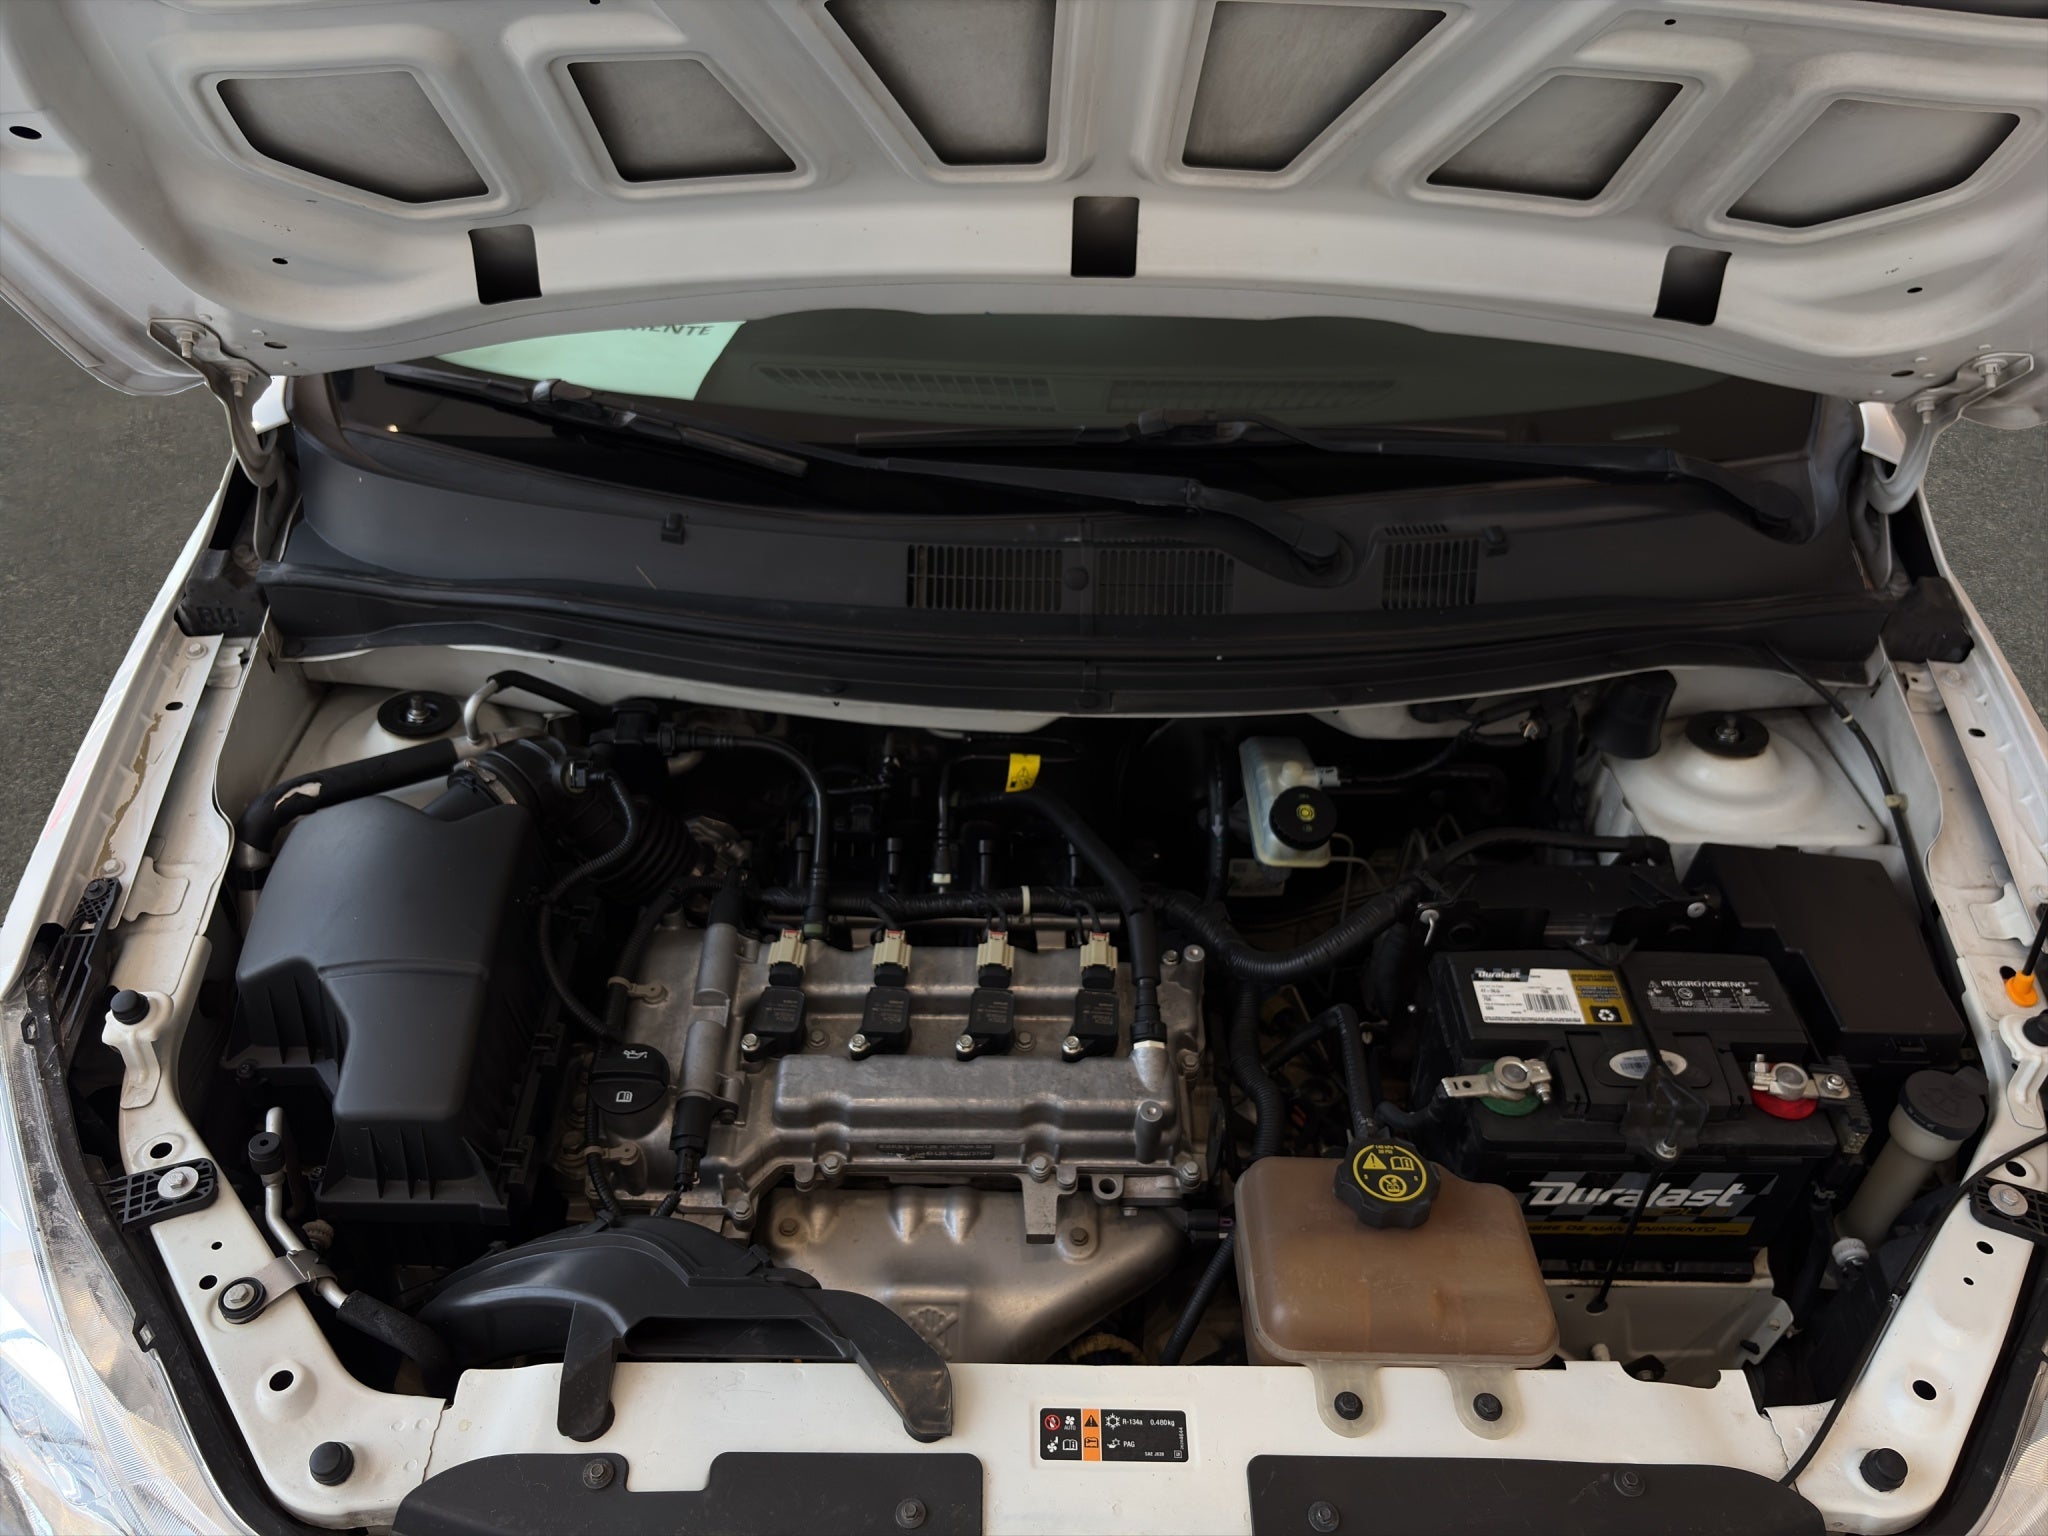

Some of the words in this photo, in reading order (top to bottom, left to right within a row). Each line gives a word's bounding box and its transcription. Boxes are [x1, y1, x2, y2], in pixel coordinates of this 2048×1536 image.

[1475, 970, 1520, 978] Duralast
[1661, 980, 1746, 988] PELIGRO/VENENO
[1528, 1181, 1746, 1207] Duralast
[1122, 1418, 1143, 1426] R-134a
[1123, 1440, 1136, 1448] PAG
